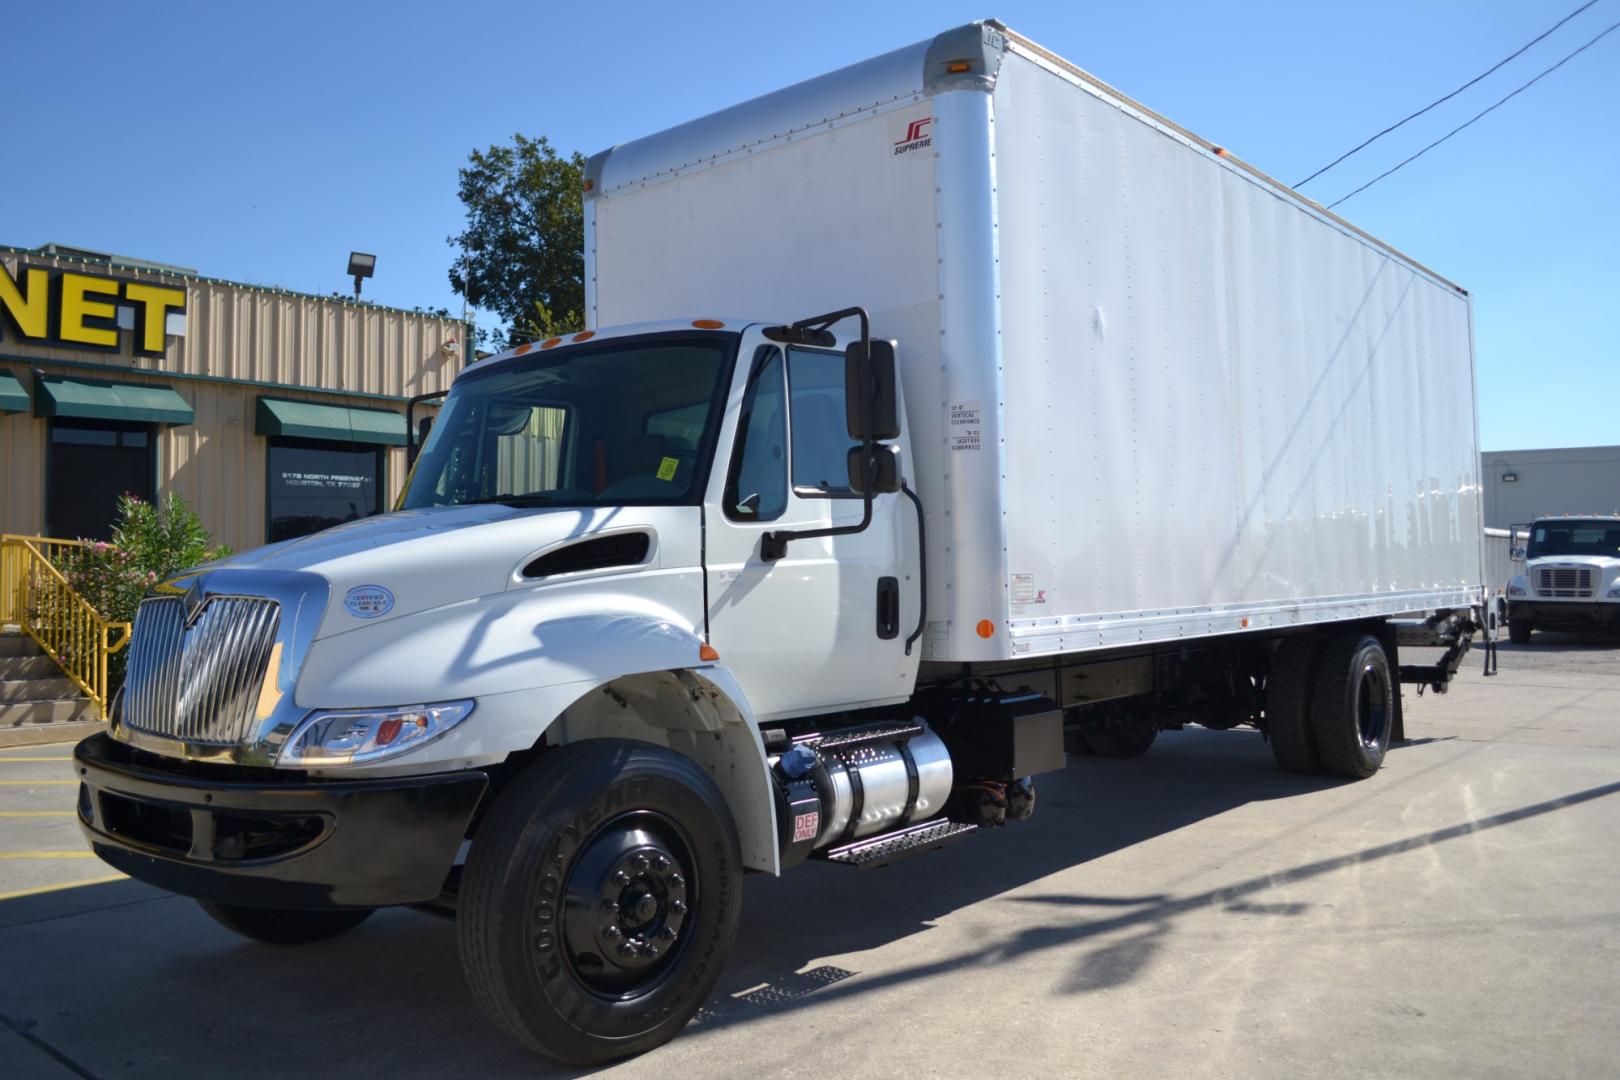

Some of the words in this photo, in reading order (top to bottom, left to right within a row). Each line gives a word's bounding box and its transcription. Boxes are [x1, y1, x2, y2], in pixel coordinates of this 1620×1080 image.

[893, 138, 932, 155] SUPREME
[796, 813, 817, 830] DEF
[795, 827, 816, 840] ONLY
